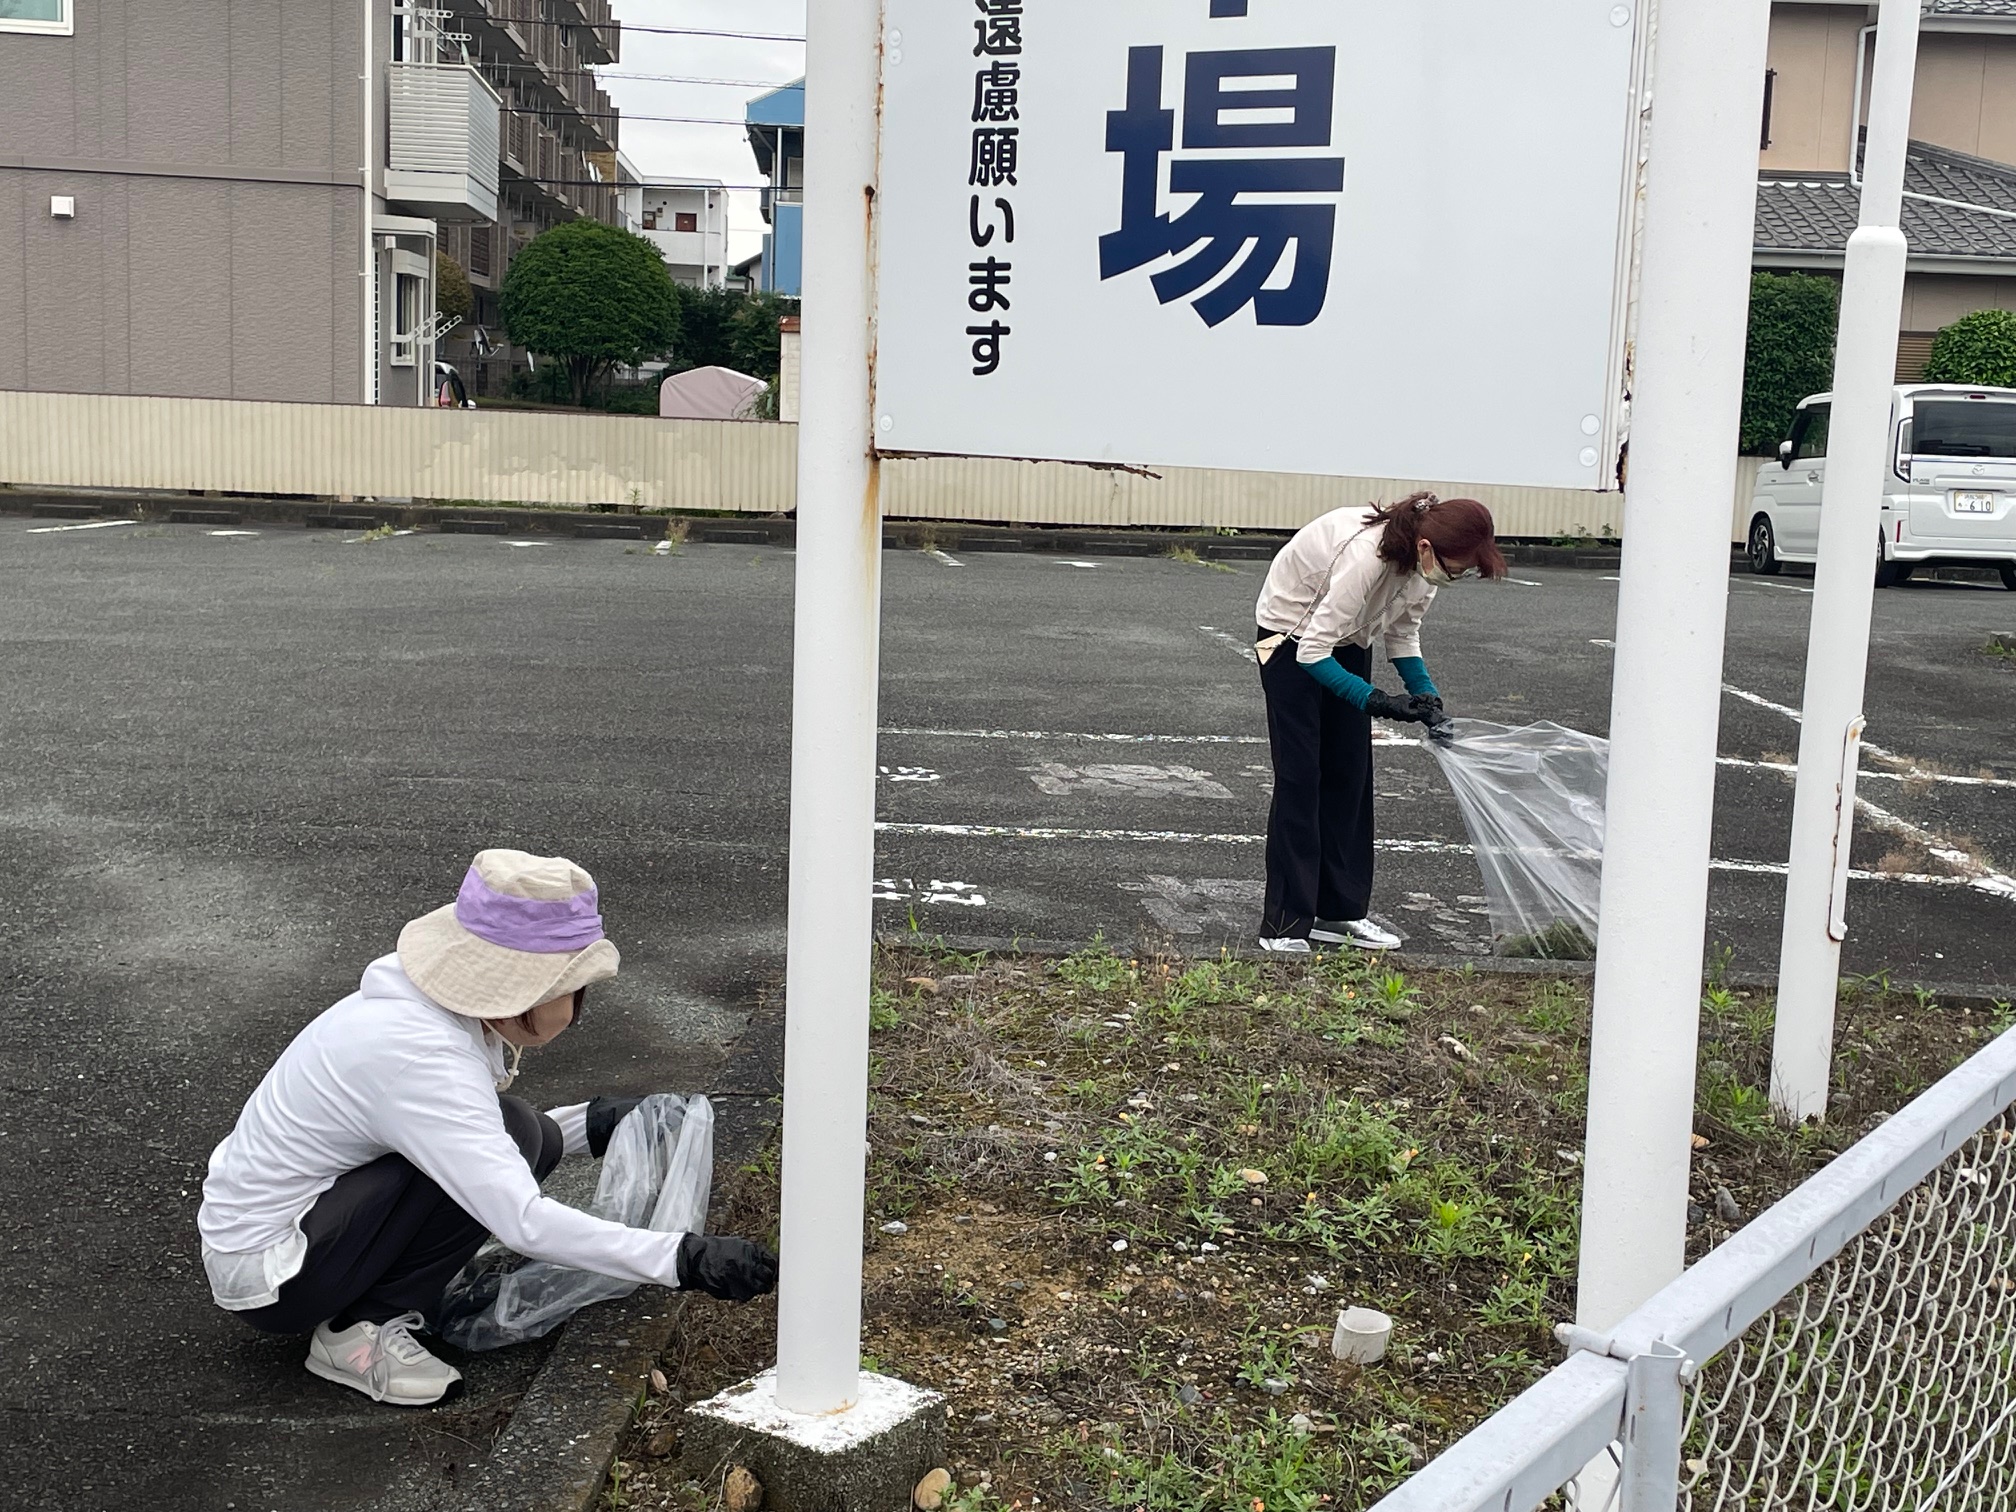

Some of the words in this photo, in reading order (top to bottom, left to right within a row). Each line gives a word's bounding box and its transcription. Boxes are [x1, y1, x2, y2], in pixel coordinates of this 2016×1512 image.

[966, 0, 1023, 376] 遠慮願います
[1099, 0, 1344, 328] 場
